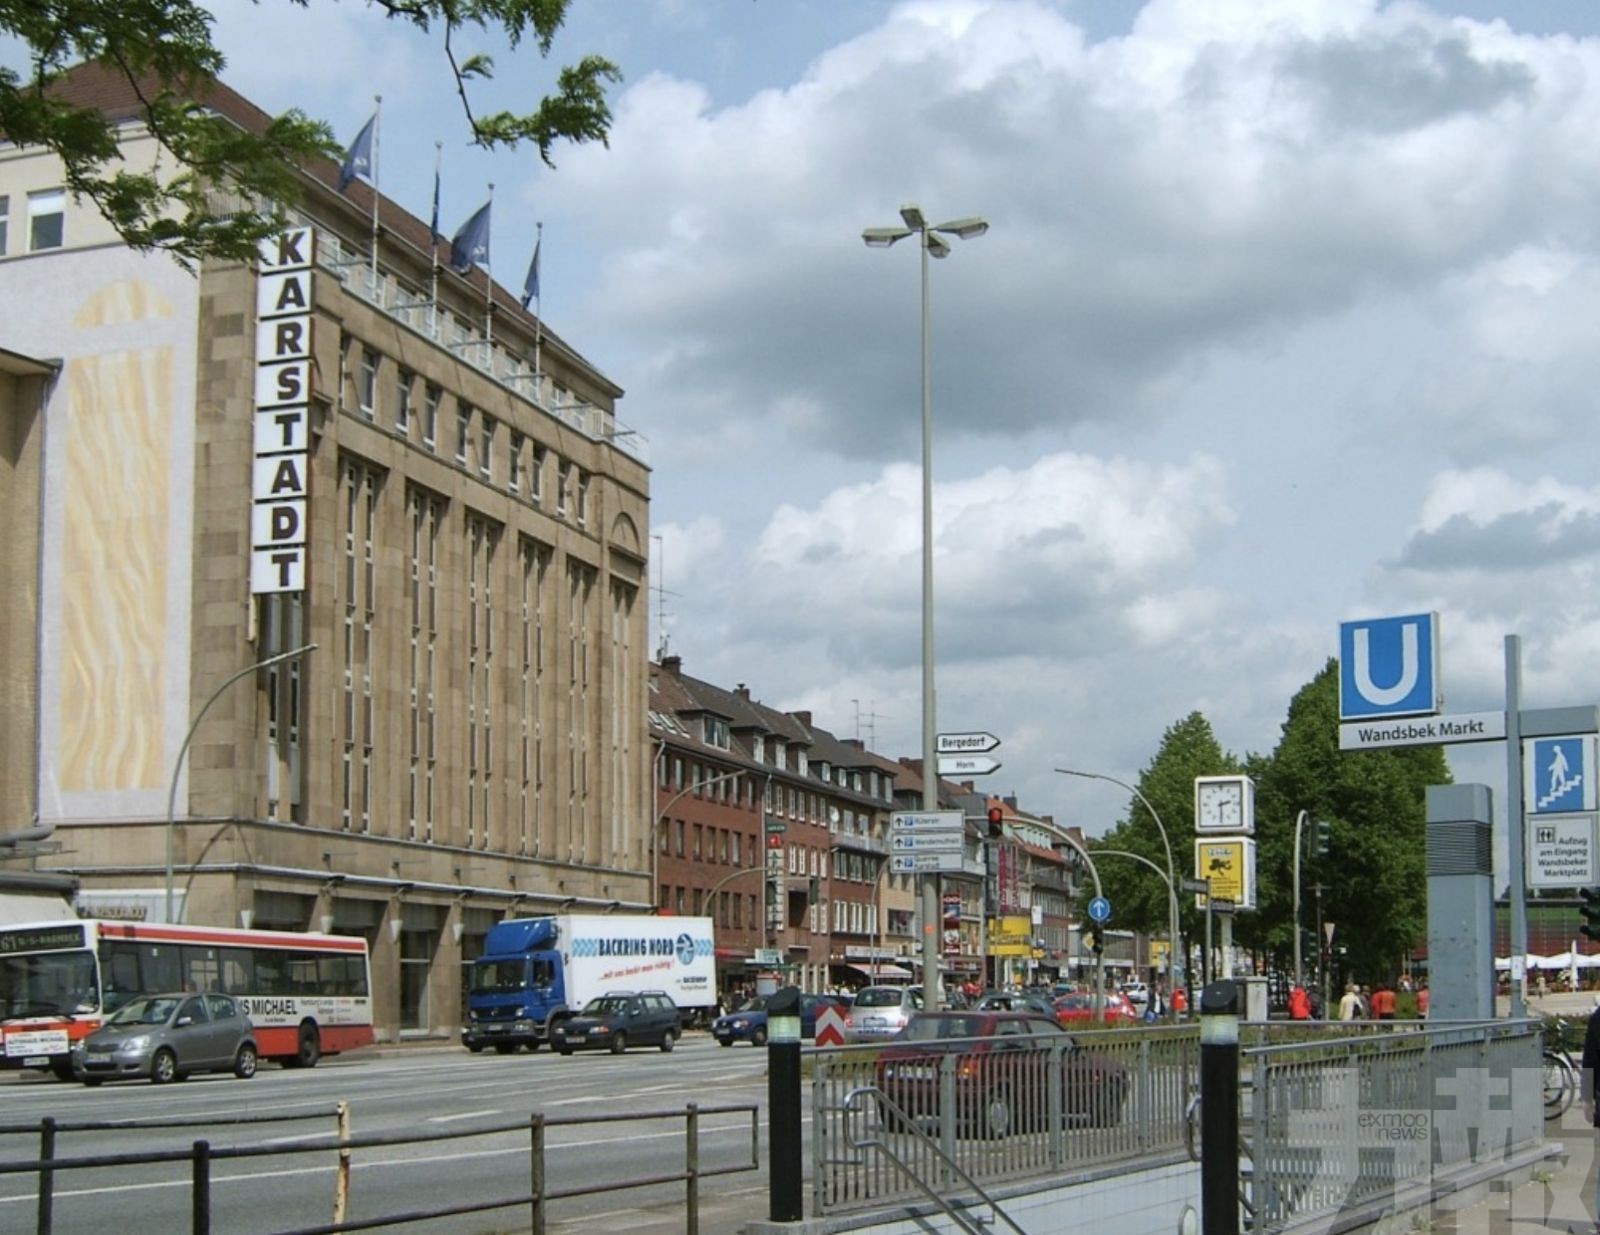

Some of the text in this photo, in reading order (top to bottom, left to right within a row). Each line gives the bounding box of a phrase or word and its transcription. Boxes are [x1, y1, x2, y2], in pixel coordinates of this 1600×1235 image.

[271, 231, 306, 588] KARSTADT
[1353, 623, 1419, 706] U
[1358, 719, 1485, 742] Wandsbek Markt
[941, 736, 986, 749] Bergedorf
[1558, 836, 1588, 847] Aufzug
[1554, 848, 1588, 858] Eingang
[1537, 858, 1588, 867] Wandsbeker
[1543, 868, 1588, 878] Marktplatz
[648, 938, 675, 957] NORD
[252, 999, 298, 1015] MICHAEL
